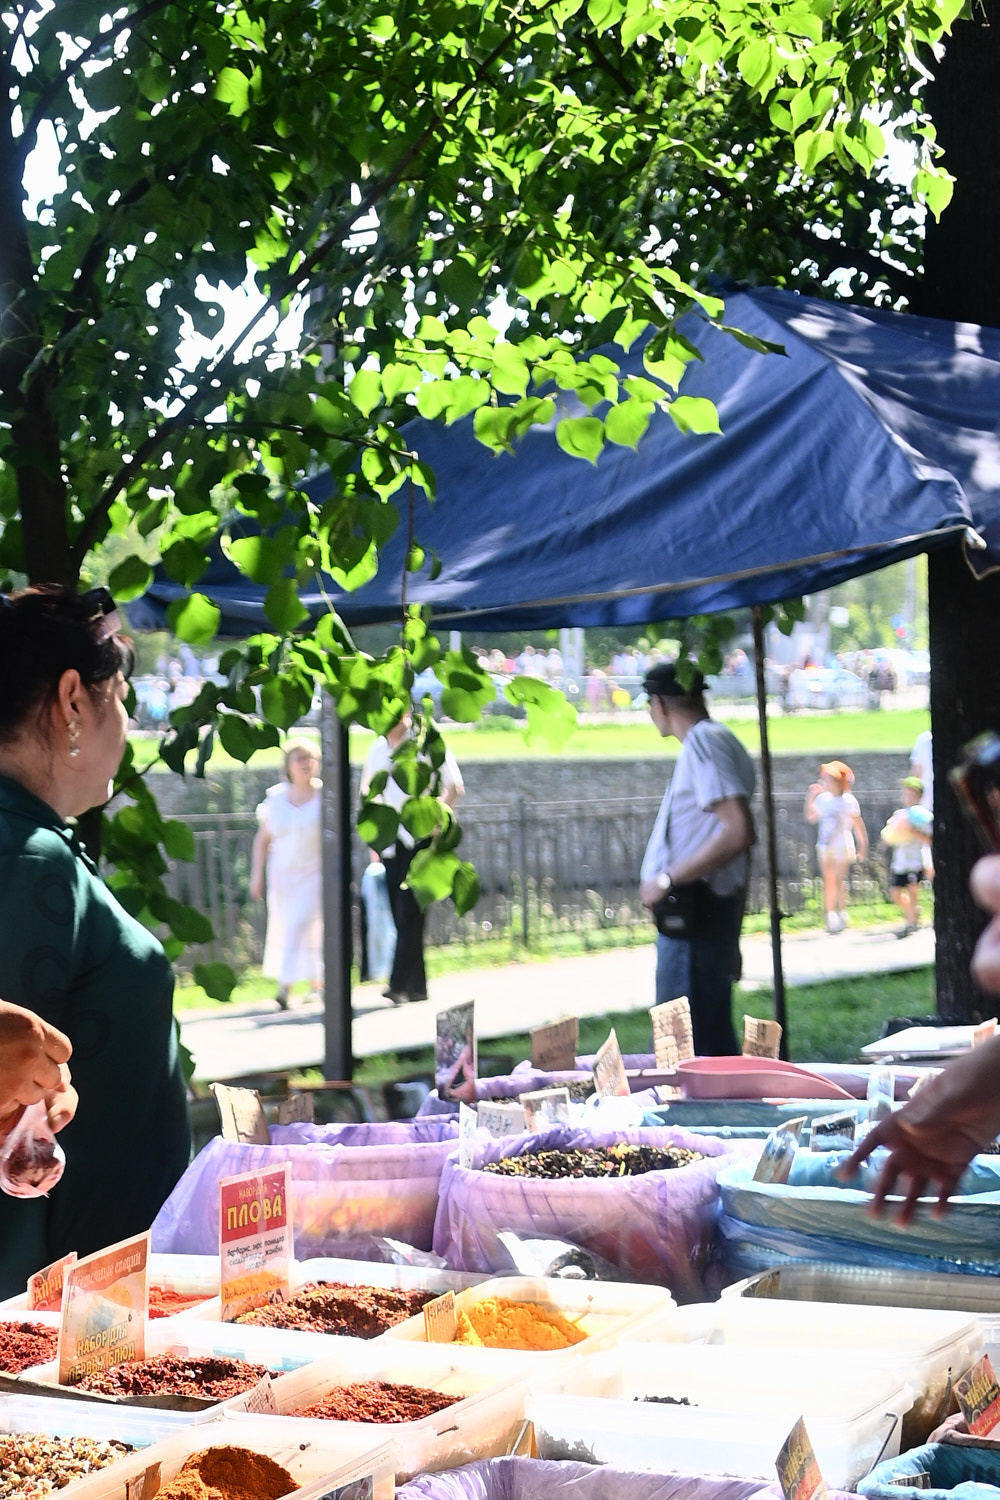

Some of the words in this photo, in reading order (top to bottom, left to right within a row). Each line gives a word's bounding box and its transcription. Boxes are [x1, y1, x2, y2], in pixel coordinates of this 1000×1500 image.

[227, 1194, 282, 1230] ПЛОВА
[76, 1329, 107, 1358] НАБОР
[109, 1321, 128, 1346] ДЛЯ
[68, 1351, 107, 1383] ПЕРВЫХ
[108, 1341, 135, 1367] БЛЮД
